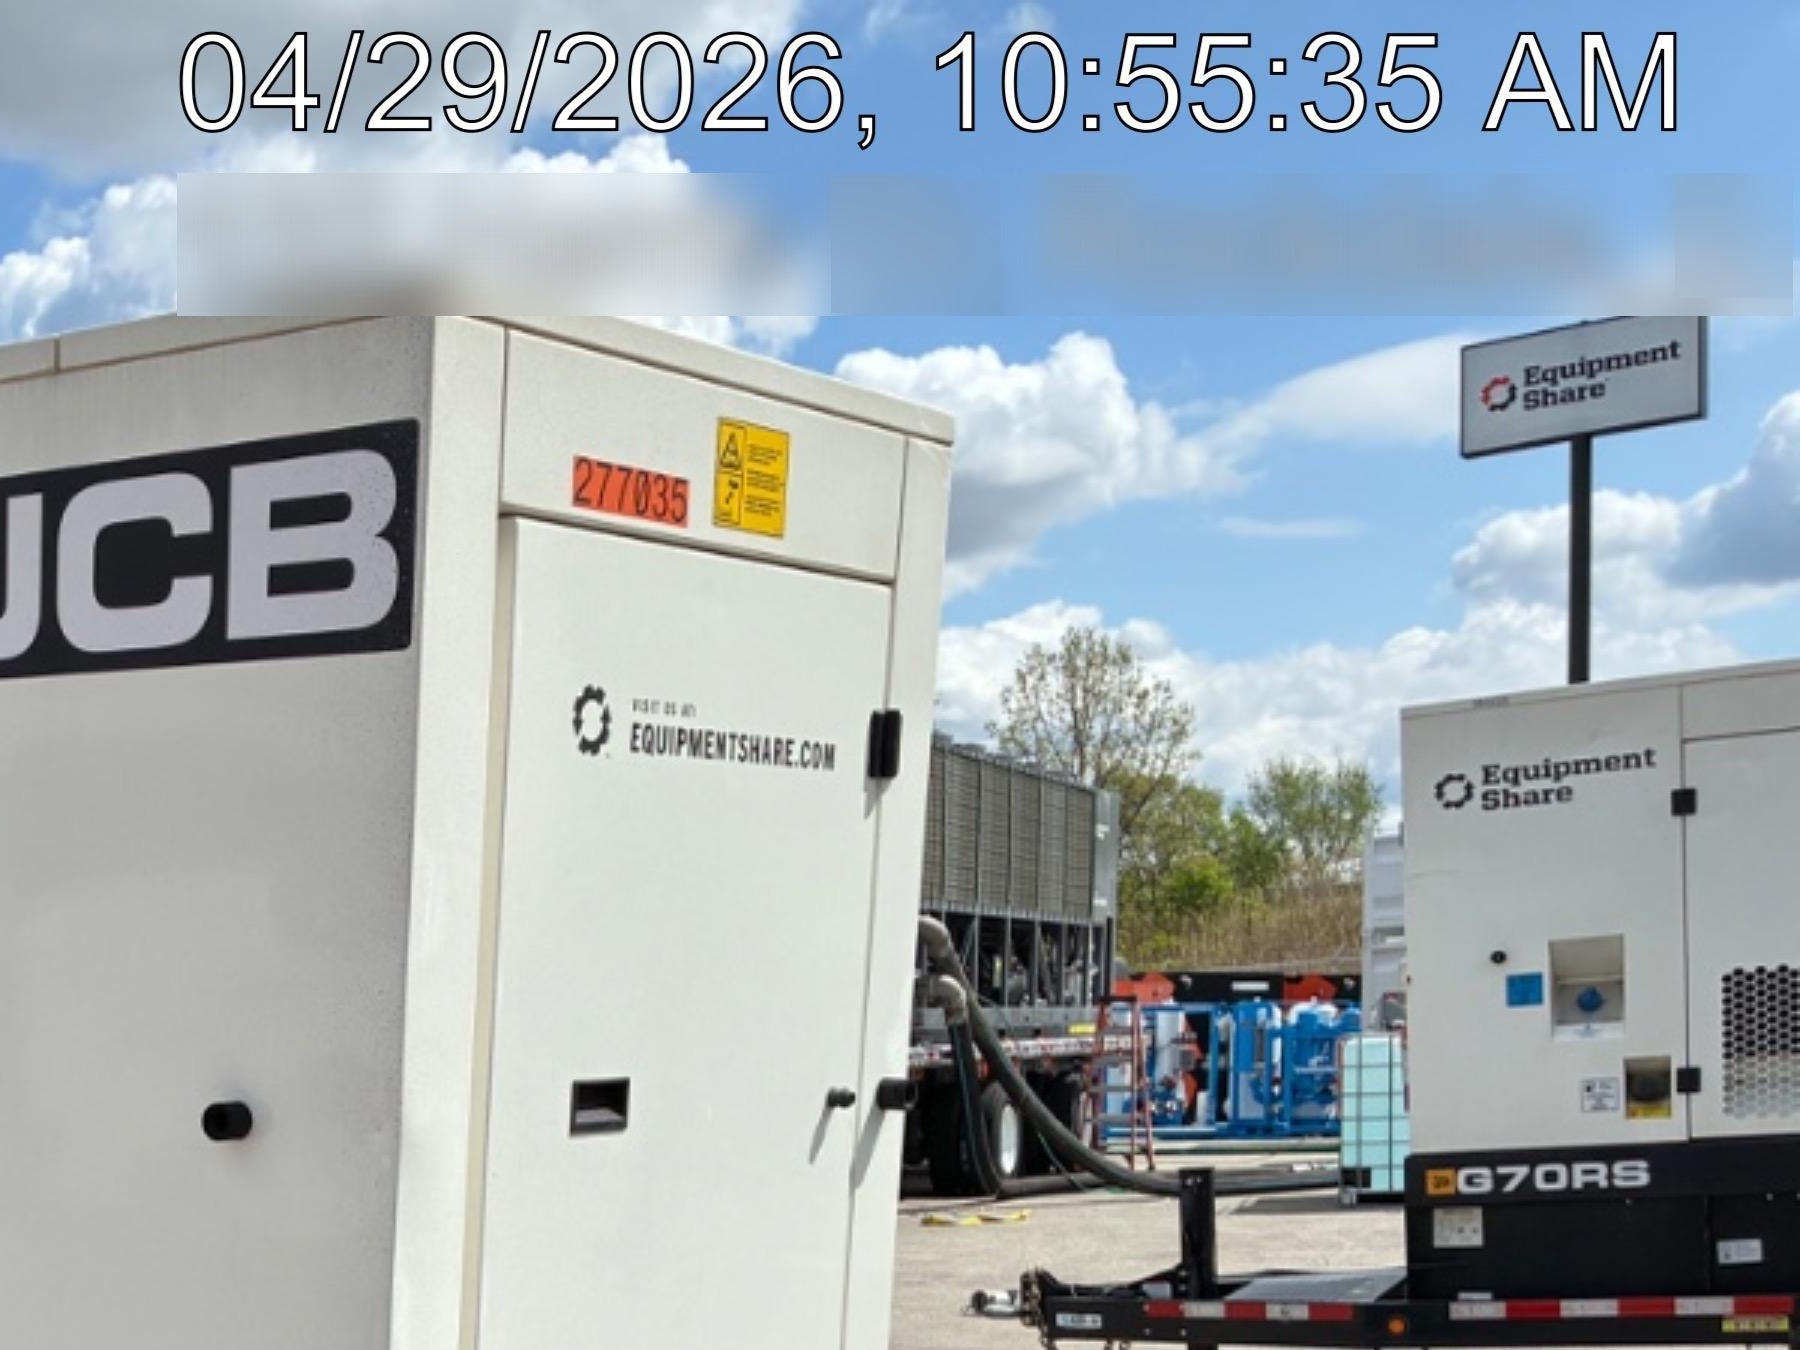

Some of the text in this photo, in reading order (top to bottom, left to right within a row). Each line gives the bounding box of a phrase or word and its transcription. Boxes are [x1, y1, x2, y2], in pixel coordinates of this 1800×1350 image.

[1523, 340, 1681, 387] Equipment
[1523, 380, 1606, 411] Share
[574, 458, 688, 523] 277035
[630, 722, 835, 771] EQUIPMENTSHARE.COM
[1481, 748, 1656, 786] Equipment
[1481, 785, 1573, 811] Share
[1457, 1160, 1650, 1194] G70RS
